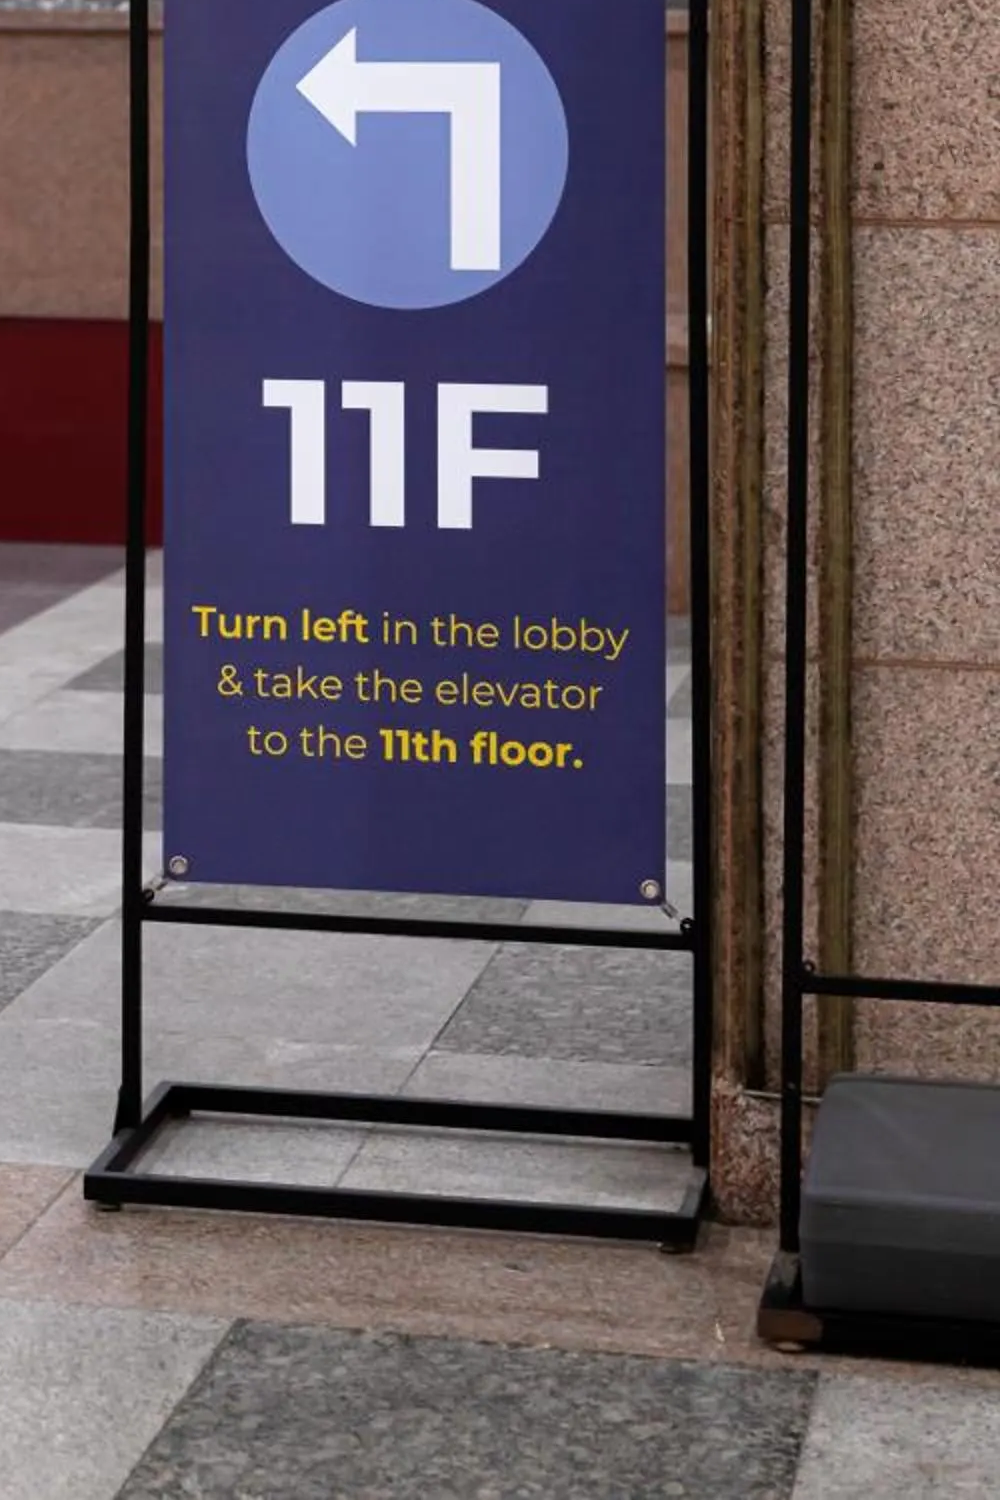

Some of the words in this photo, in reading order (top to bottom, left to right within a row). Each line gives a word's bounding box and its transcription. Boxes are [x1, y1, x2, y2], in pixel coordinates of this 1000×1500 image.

[261, 378, 549, 530] 11F
[191, 605, 288, 640] Turn
[301, 607, 370, 644] left
[382, 610, 418, 645] in
[430, 613, 500, 648] the
[513, 615, 630, 661] lobby
[217, 664, 244, 696] &
[253, 665, 344, 700] take
[354, 669, 423, 703] the
[435, 672, 603, 710] elevator
[247, 724, 288, 756] to
[299, 724, 368, 759] the
[379, 728, 457, 763] 11th
[469, 730, 584, 769] floor.
